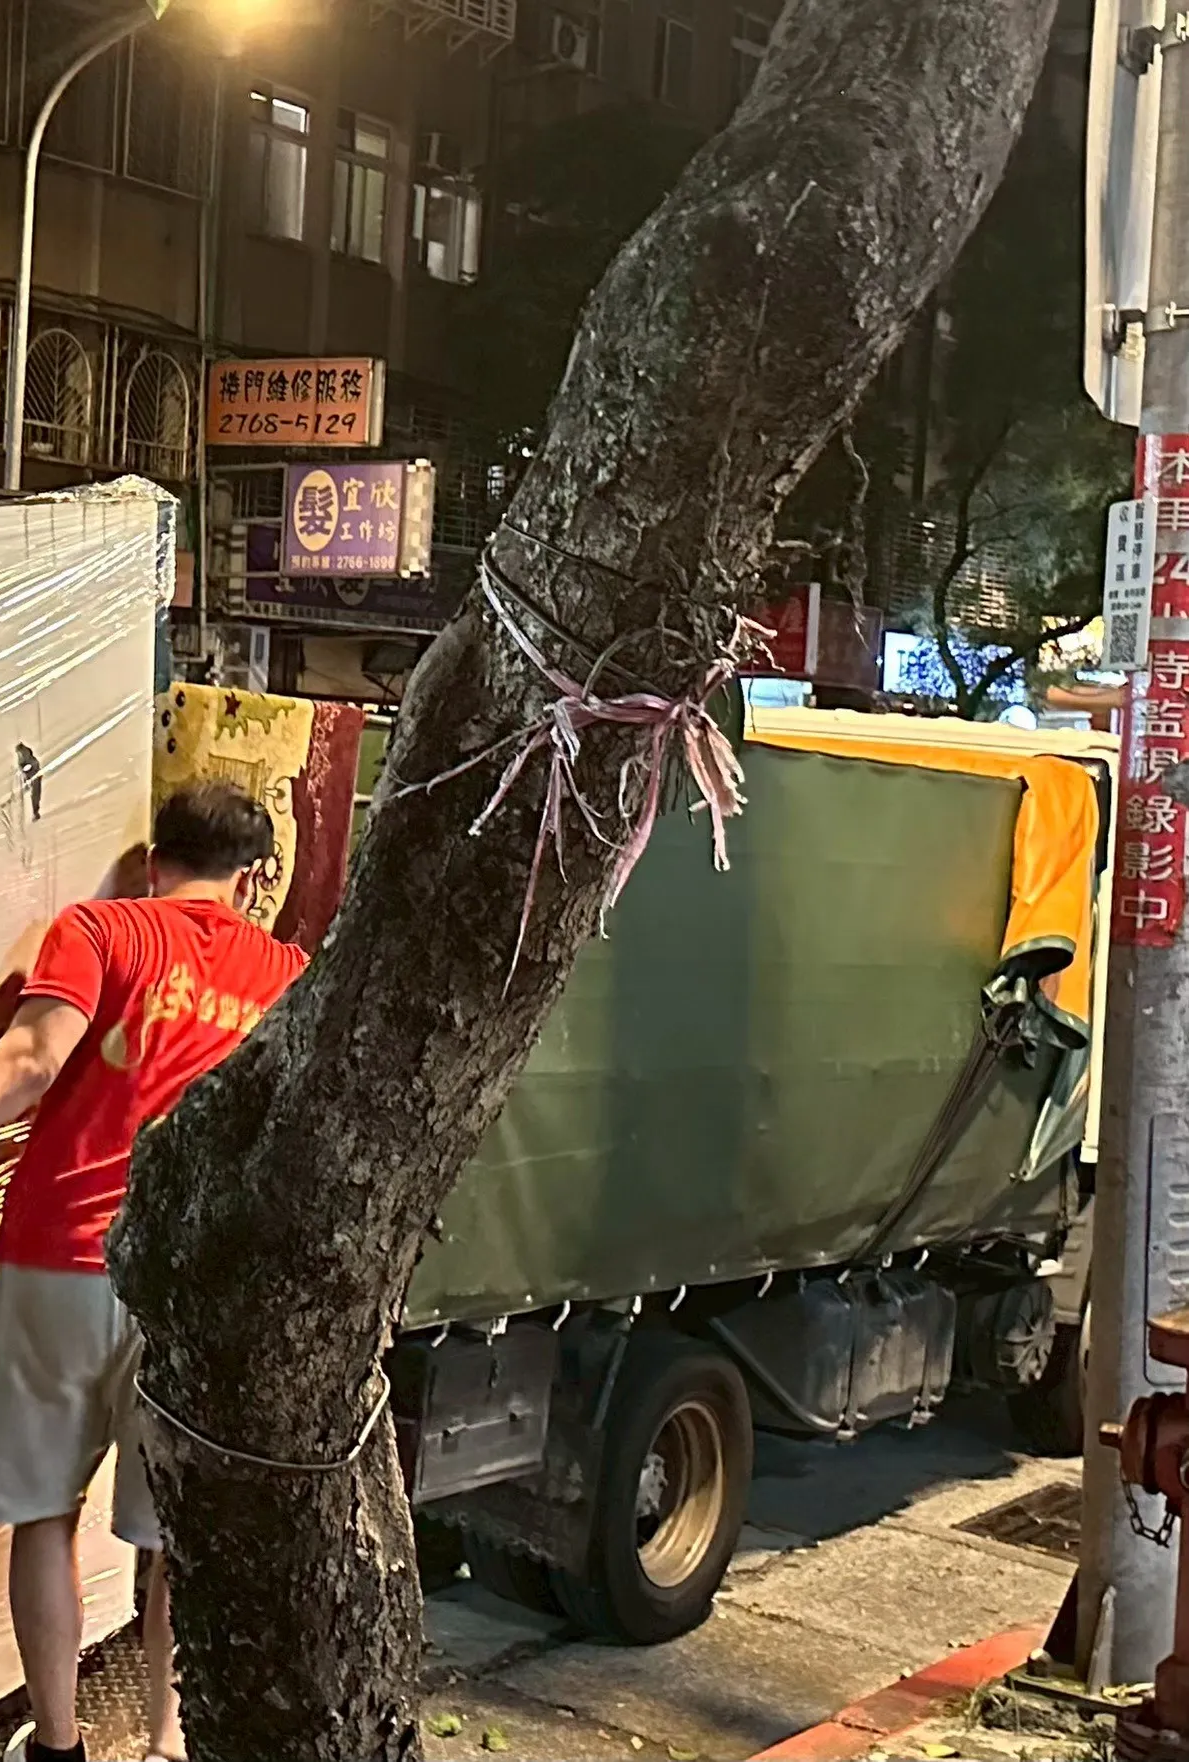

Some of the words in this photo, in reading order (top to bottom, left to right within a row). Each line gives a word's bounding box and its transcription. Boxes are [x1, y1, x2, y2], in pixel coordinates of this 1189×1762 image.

[219, 368, 363, 404] 捲門維修服務
[218, 413, 357, 435] 2768-5129
[298, 485, 333, 536] 髮
[341, 477, 400, 512] 宜欣
[340, 520, 396, 543] 工作坊
